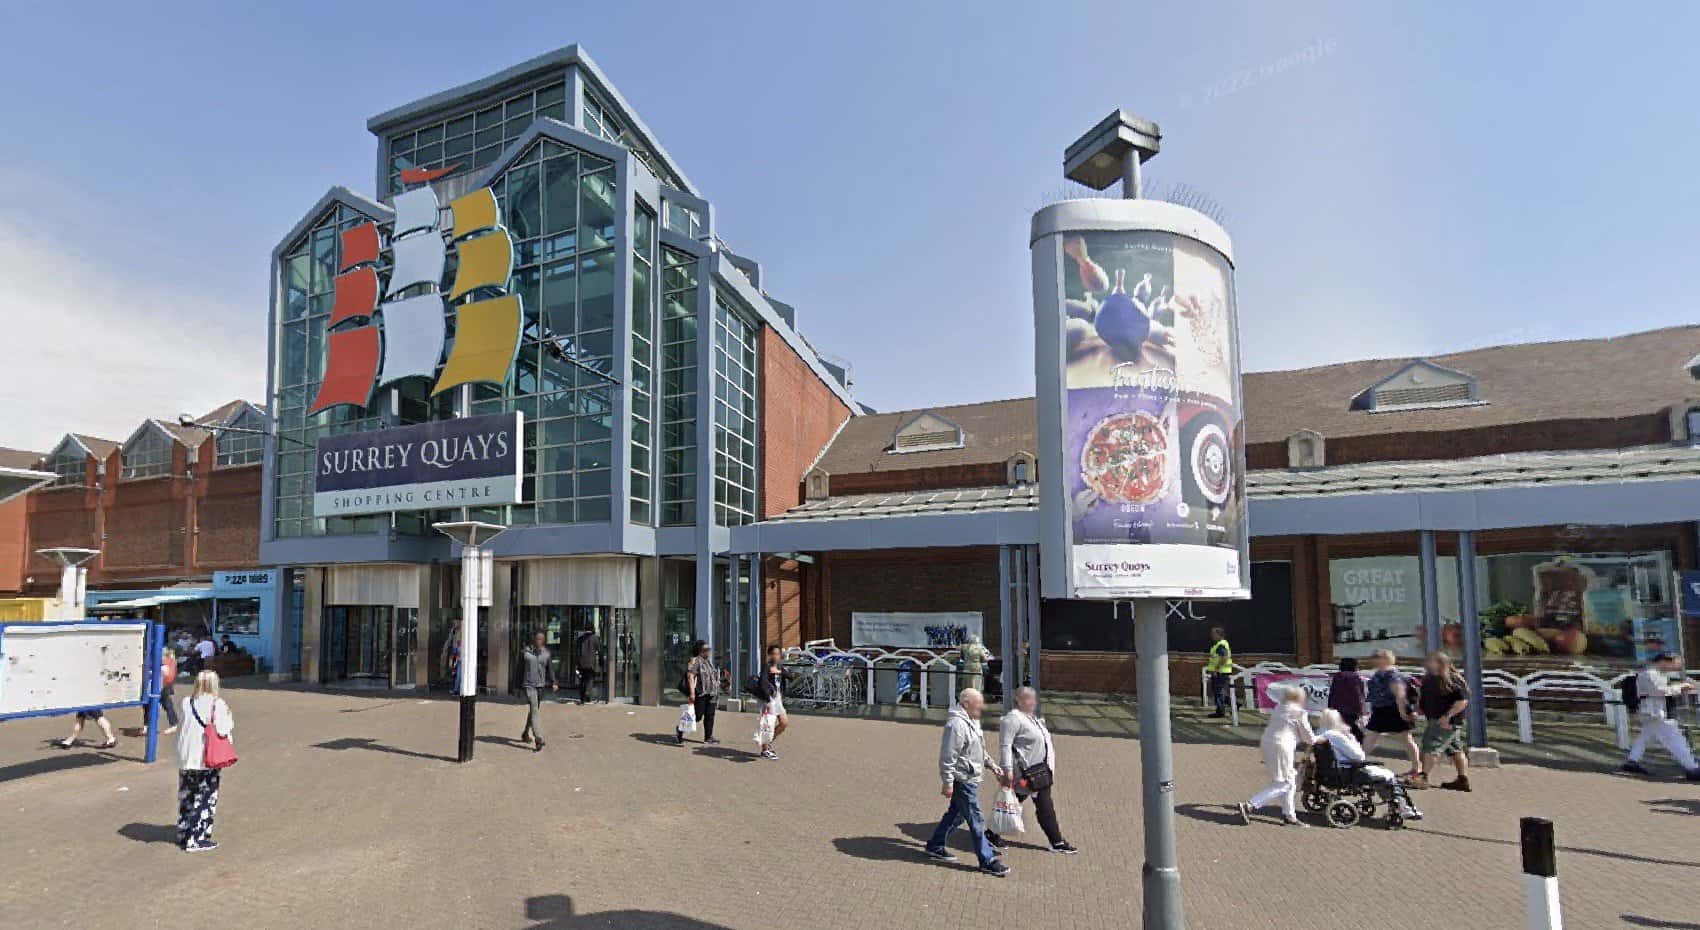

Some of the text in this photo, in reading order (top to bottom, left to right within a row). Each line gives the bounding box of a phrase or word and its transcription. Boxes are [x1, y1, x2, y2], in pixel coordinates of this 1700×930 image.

[321, 431, 508, 475] SURREY QUAYS
[333, 485, 491, 509] SHOPPING CENTRE
[1343, 568, 1404, 585] GREAT
[1344, 587, 1407, 603] VALUE
[1113, 600, 1207, 621] nxt
